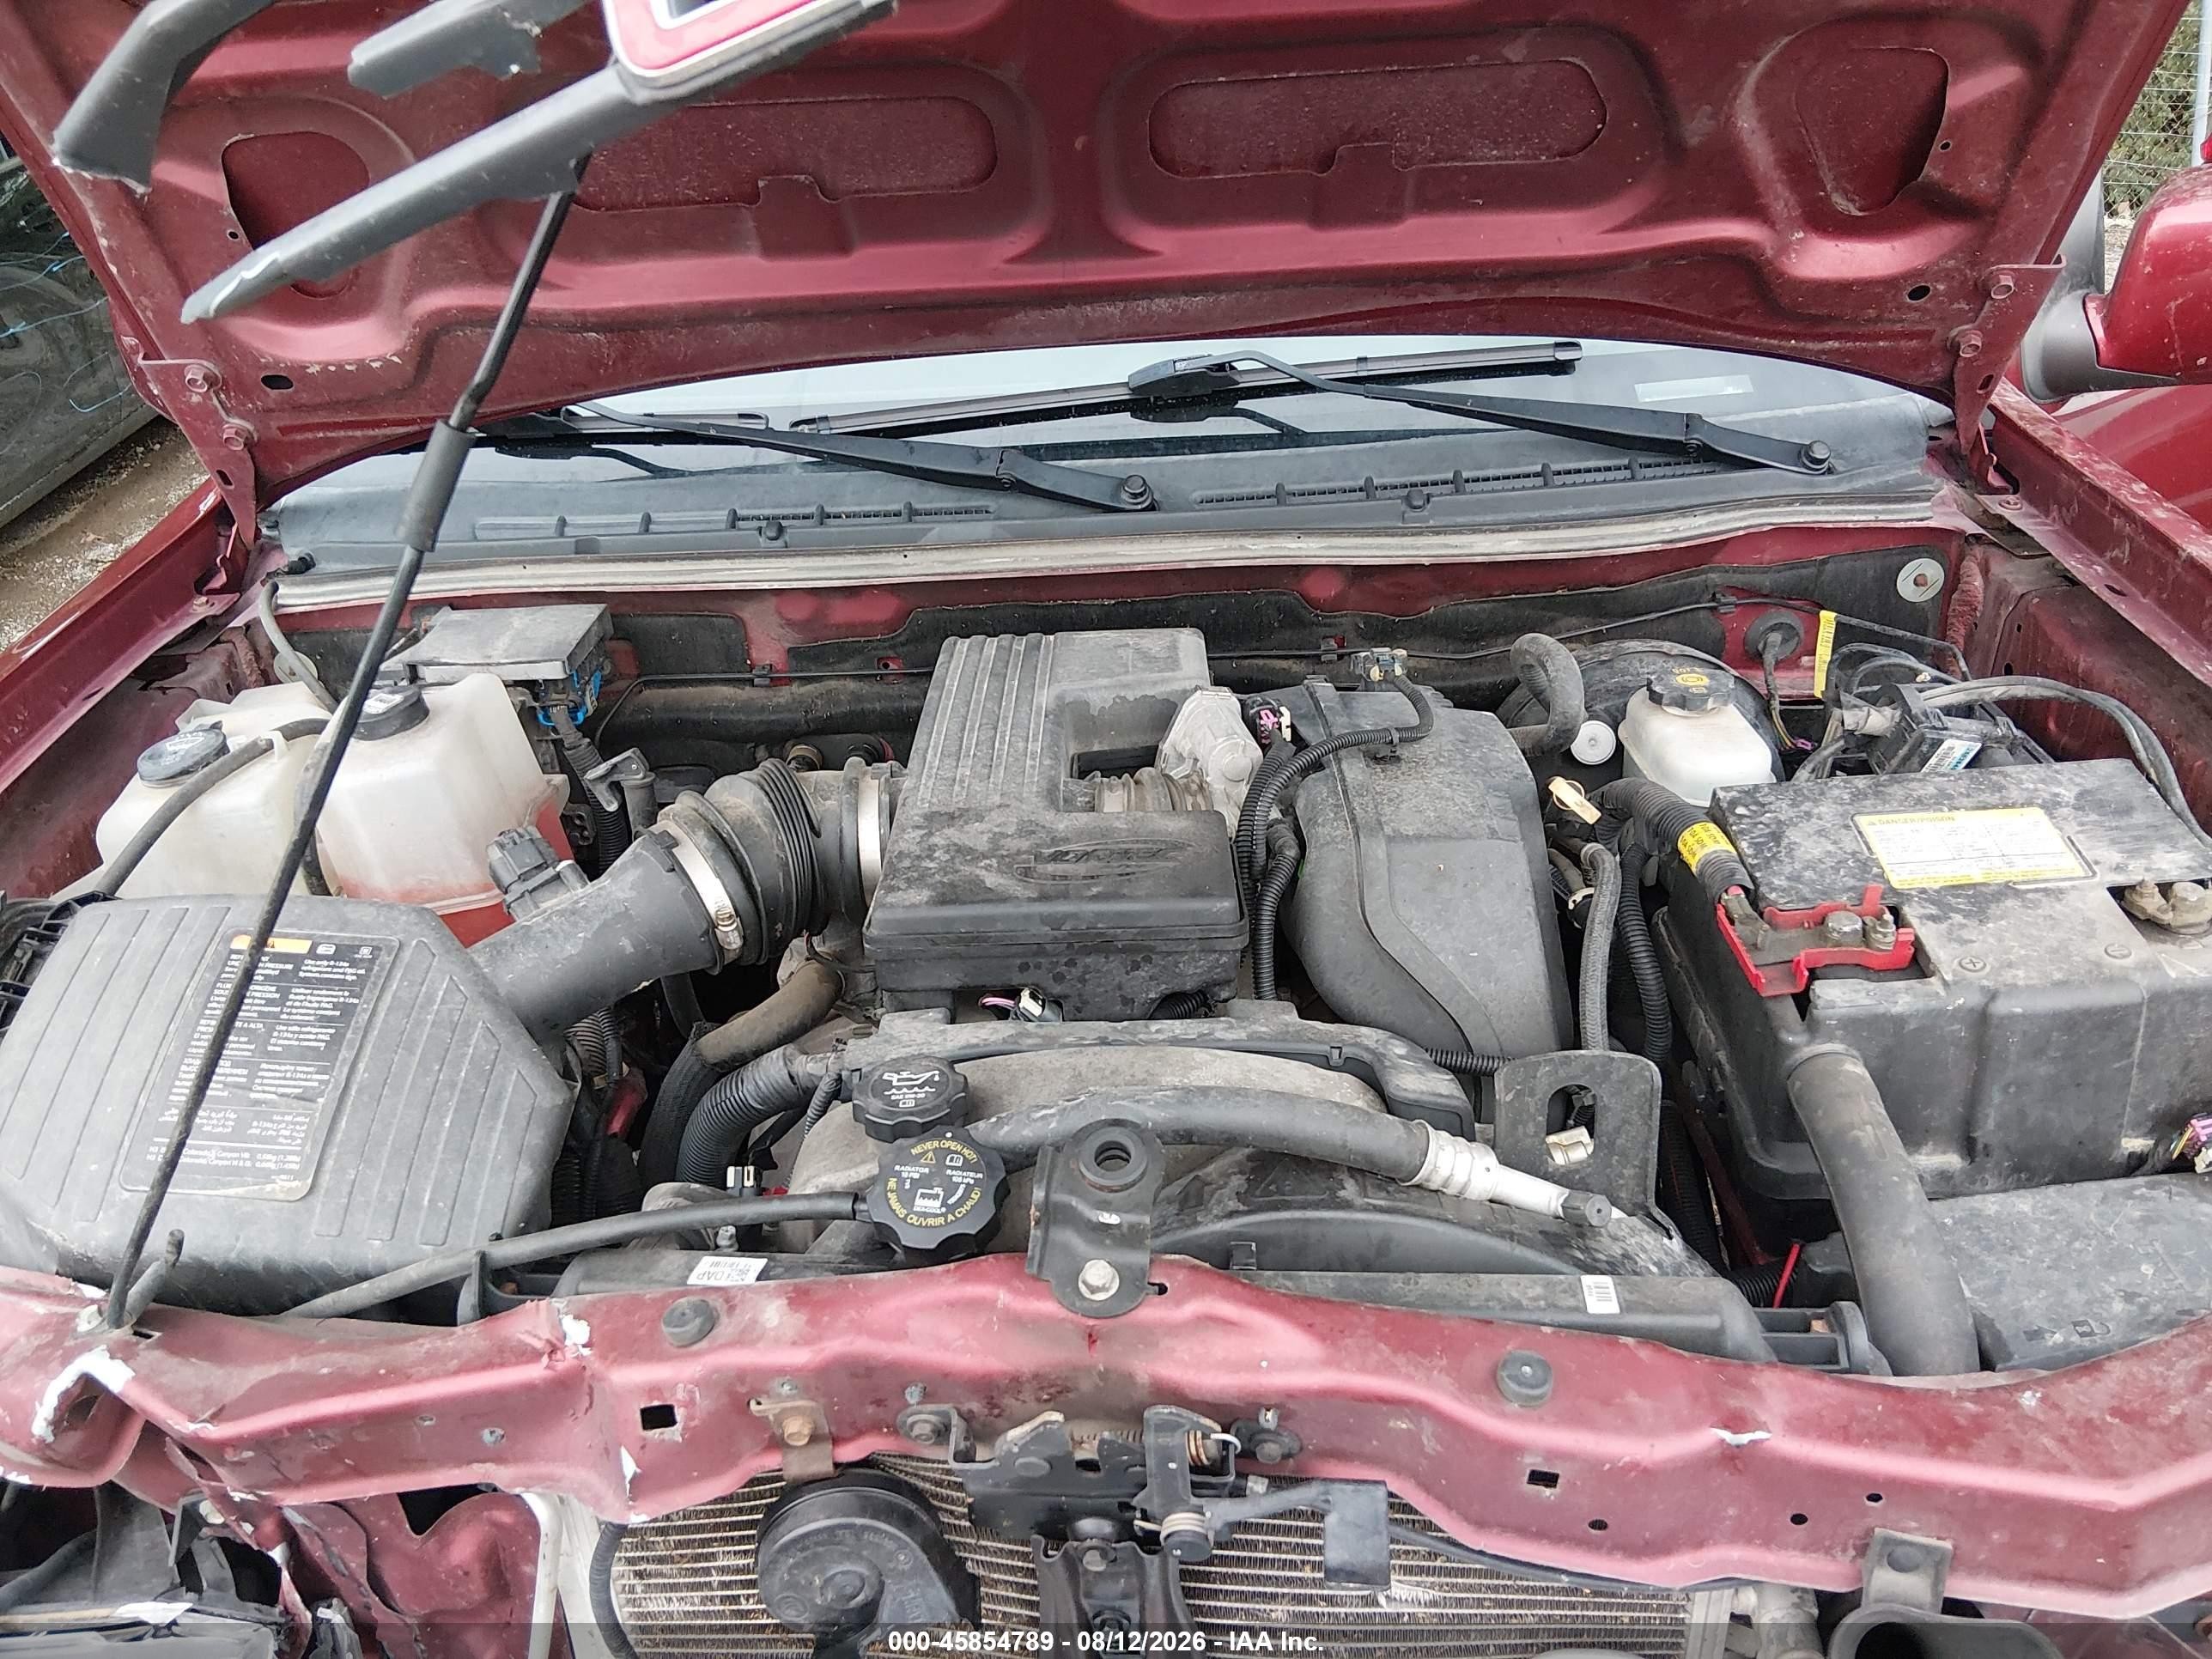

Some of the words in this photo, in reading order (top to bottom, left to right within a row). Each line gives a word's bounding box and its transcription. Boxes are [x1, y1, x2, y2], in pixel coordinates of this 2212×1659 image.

[910, 1139, 939, 1156] NEVER
[939, 1139, 963, 1153] OPEN
[894, 1164, 929, 1174] RADIATOR
[945, 1169, 983, 1179] RADIATEUR
[886, 1177, 898, 1190] NE
[906, 1213, 945, 1226] OUVRIR
